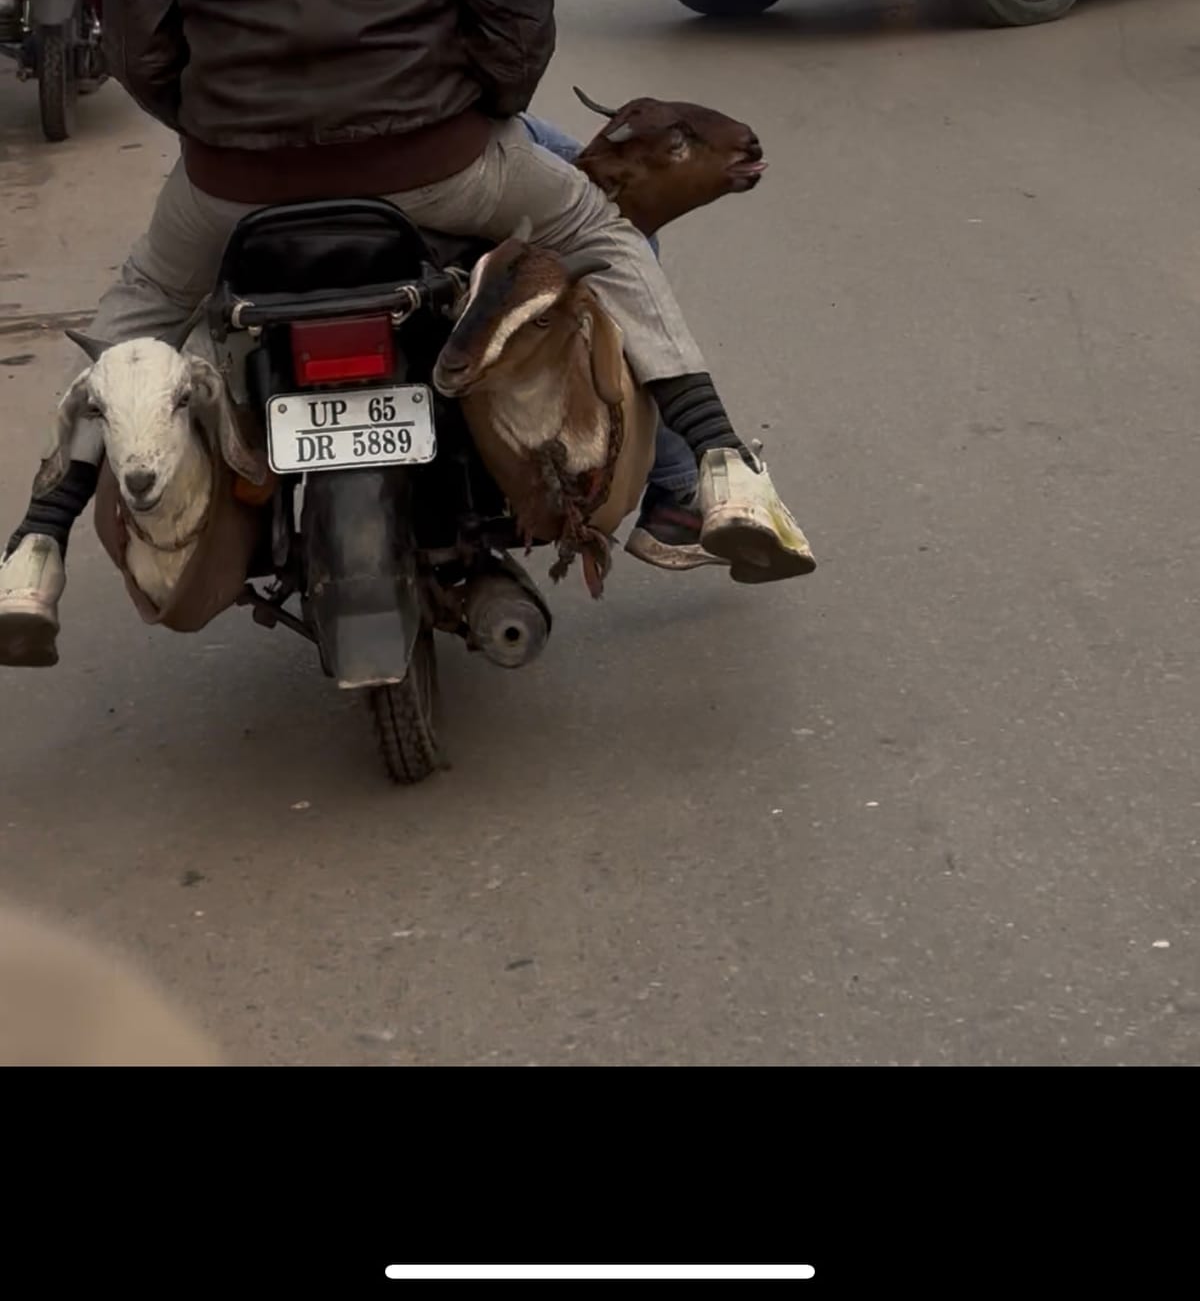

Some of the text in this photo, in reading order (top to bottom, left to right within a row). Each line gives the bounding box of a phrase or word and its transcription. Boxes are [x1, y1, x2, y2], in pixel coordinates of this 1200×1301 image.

[308, 396, 397, 428] UP 65
[296, 428, 413, 463] DR 5889
